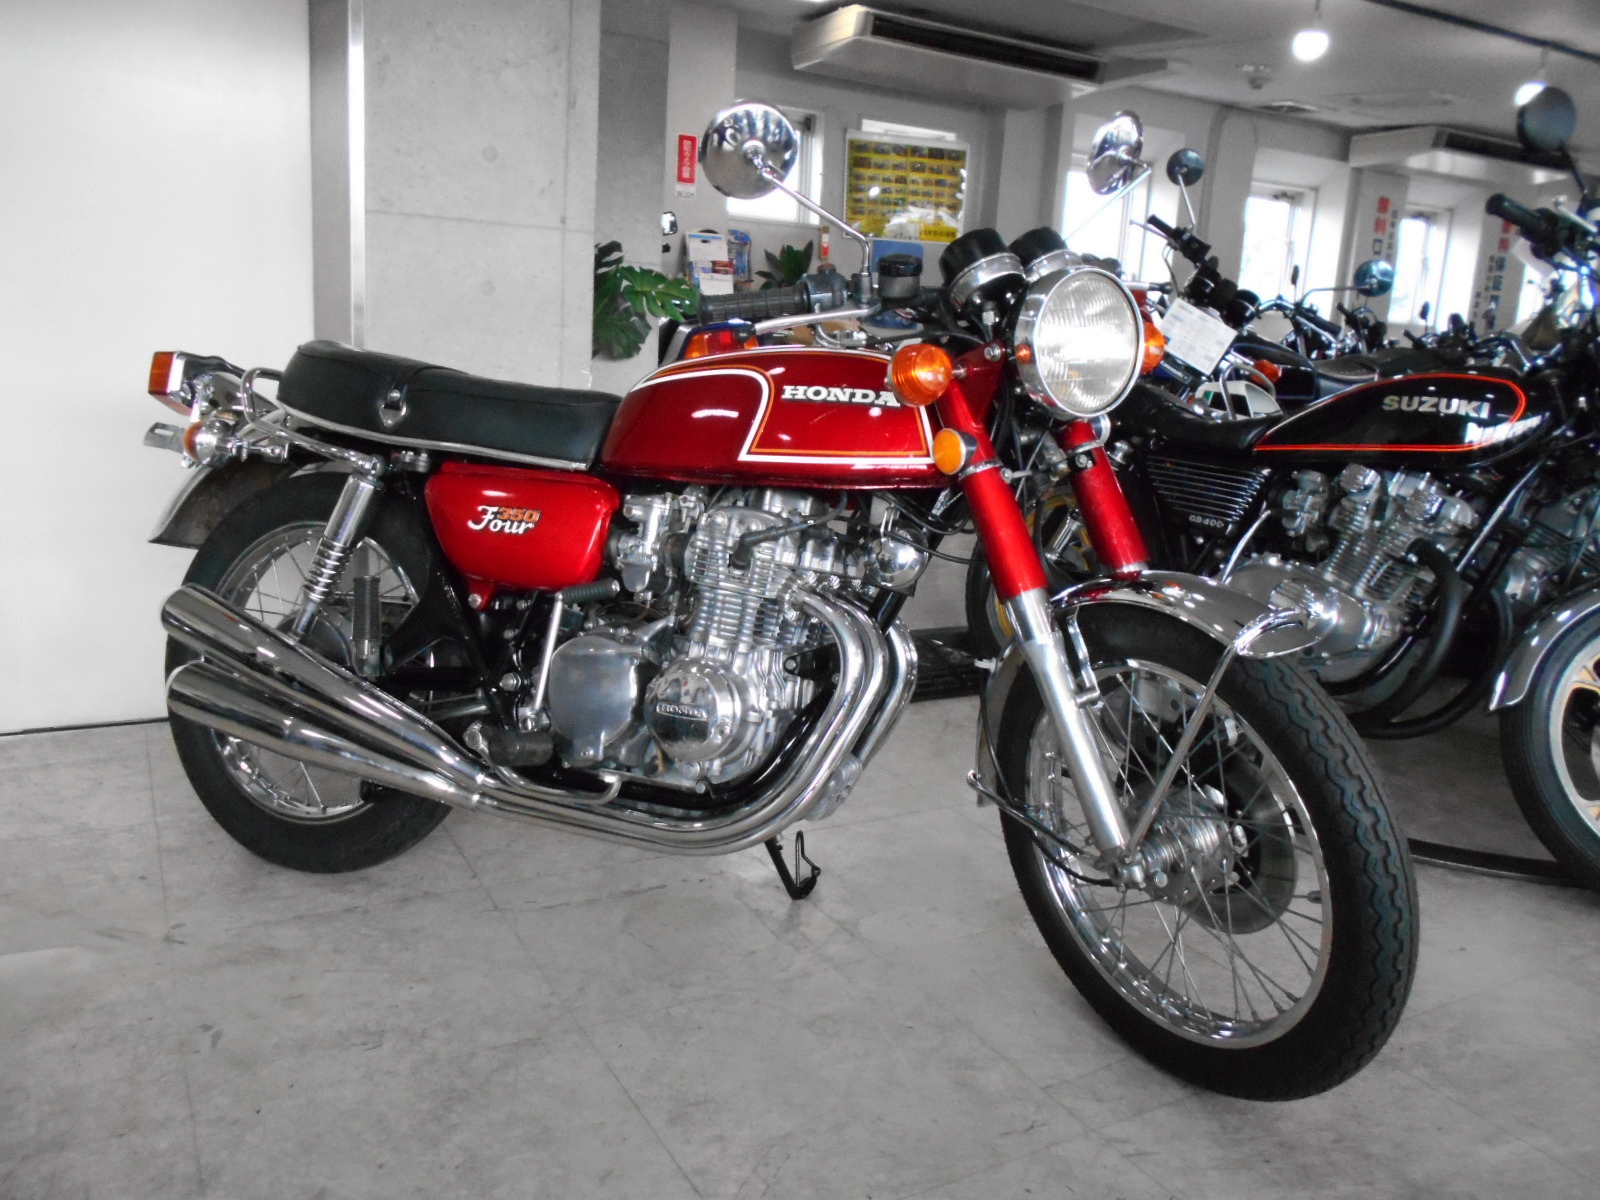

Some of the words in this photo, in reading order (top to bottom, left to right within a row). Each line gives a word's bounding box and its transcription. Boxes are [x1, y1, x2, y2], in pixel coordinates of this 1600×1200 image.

[781, 385, 901, 407] HONDA
[1382, 395, 1490, 419] SUZUKI
[467, 505, 535, 534] Four
[497, 506, 541, 523] 350
